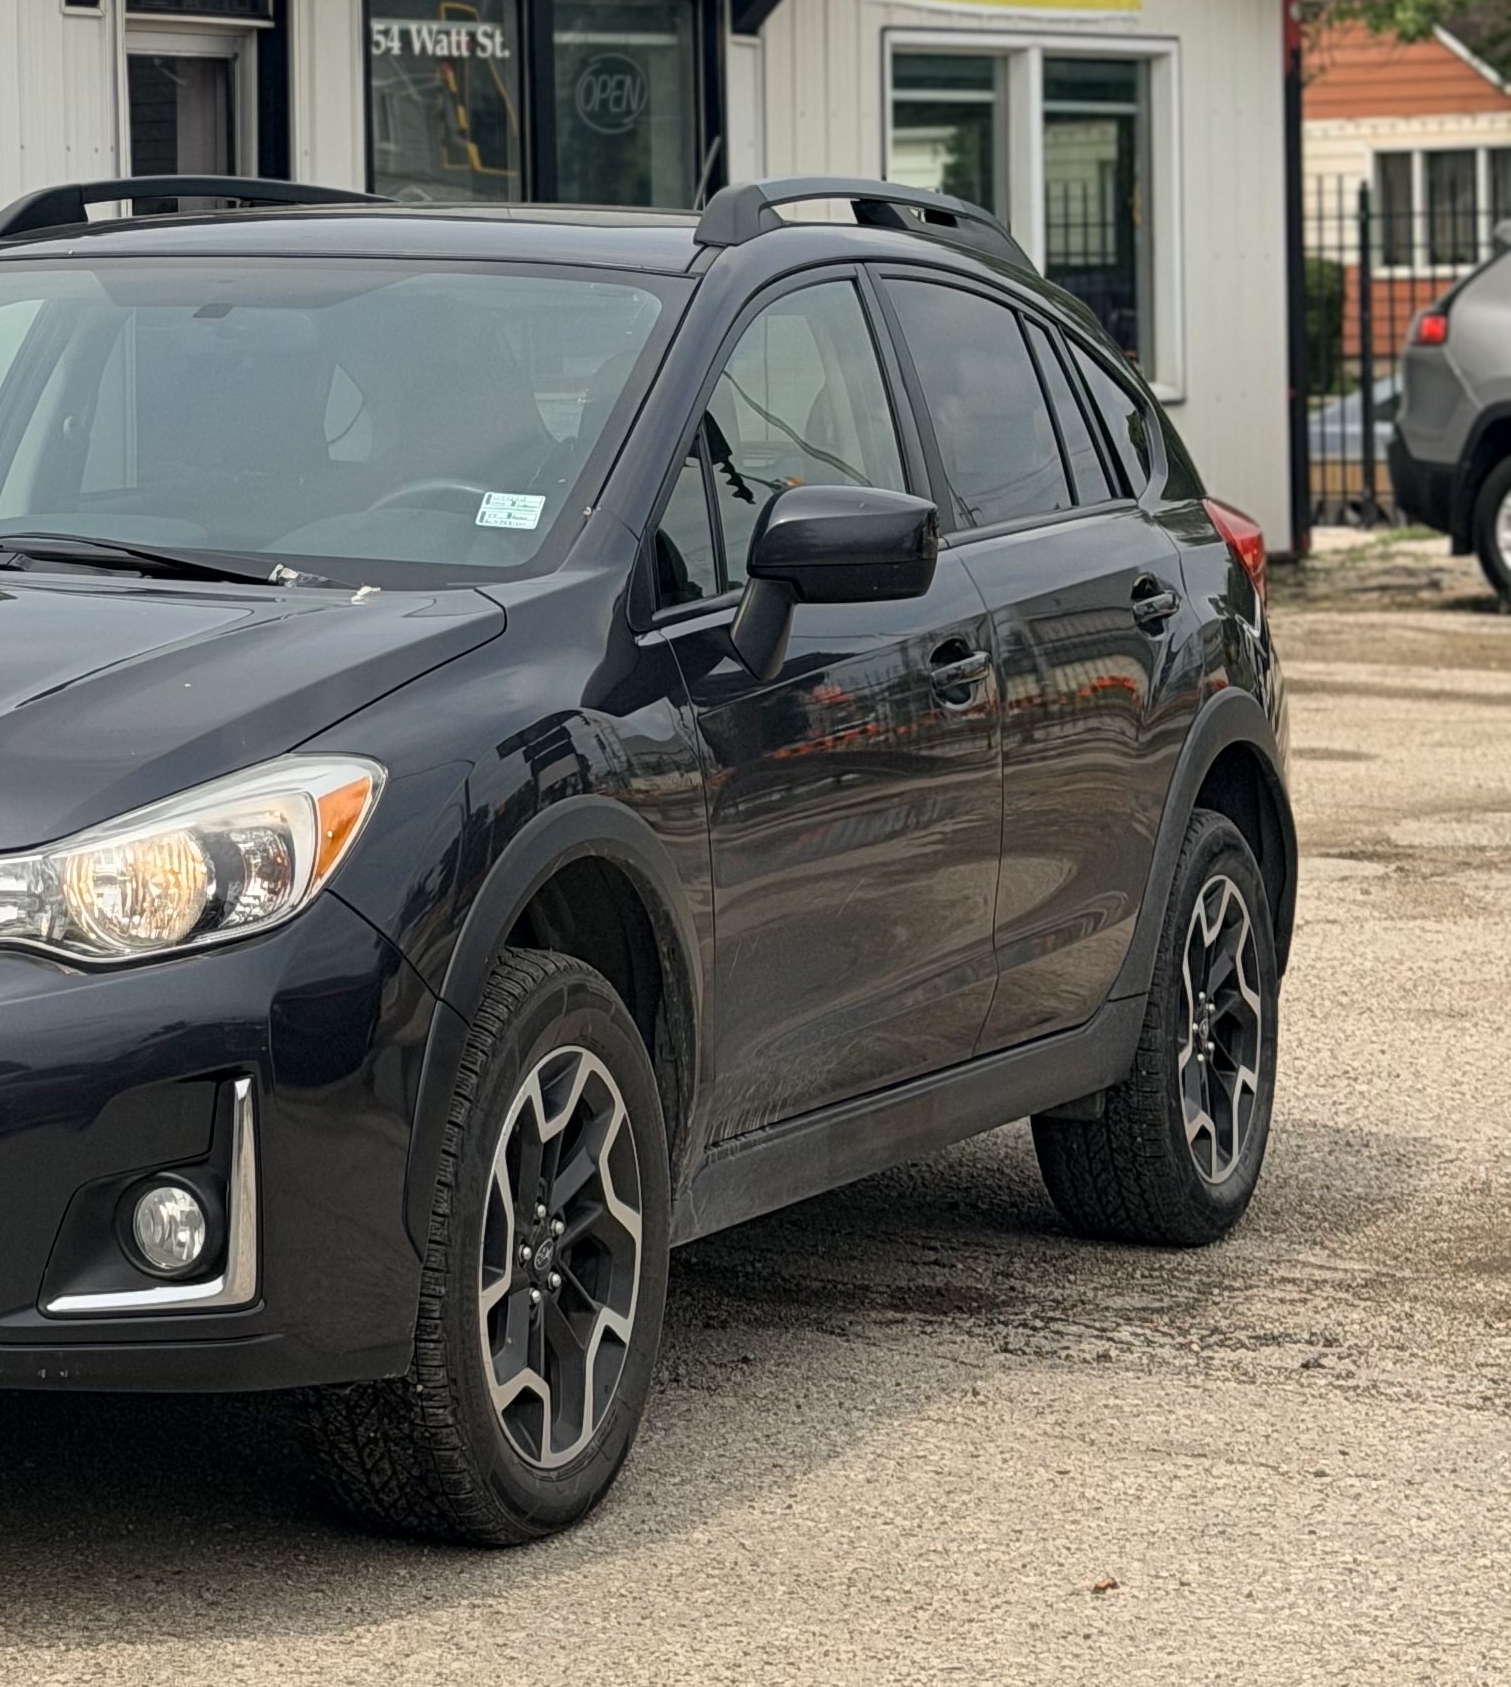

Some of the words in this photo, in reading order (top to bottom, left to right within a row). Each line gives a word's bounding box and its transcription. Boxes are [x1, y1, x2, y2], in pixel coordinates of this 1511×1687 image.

[371, 24, 402, 55] 54
[409, 24, 471, 57] Watt
[476, 25, 511, 58] St.
[580, 74, 642, 112] OPEN
